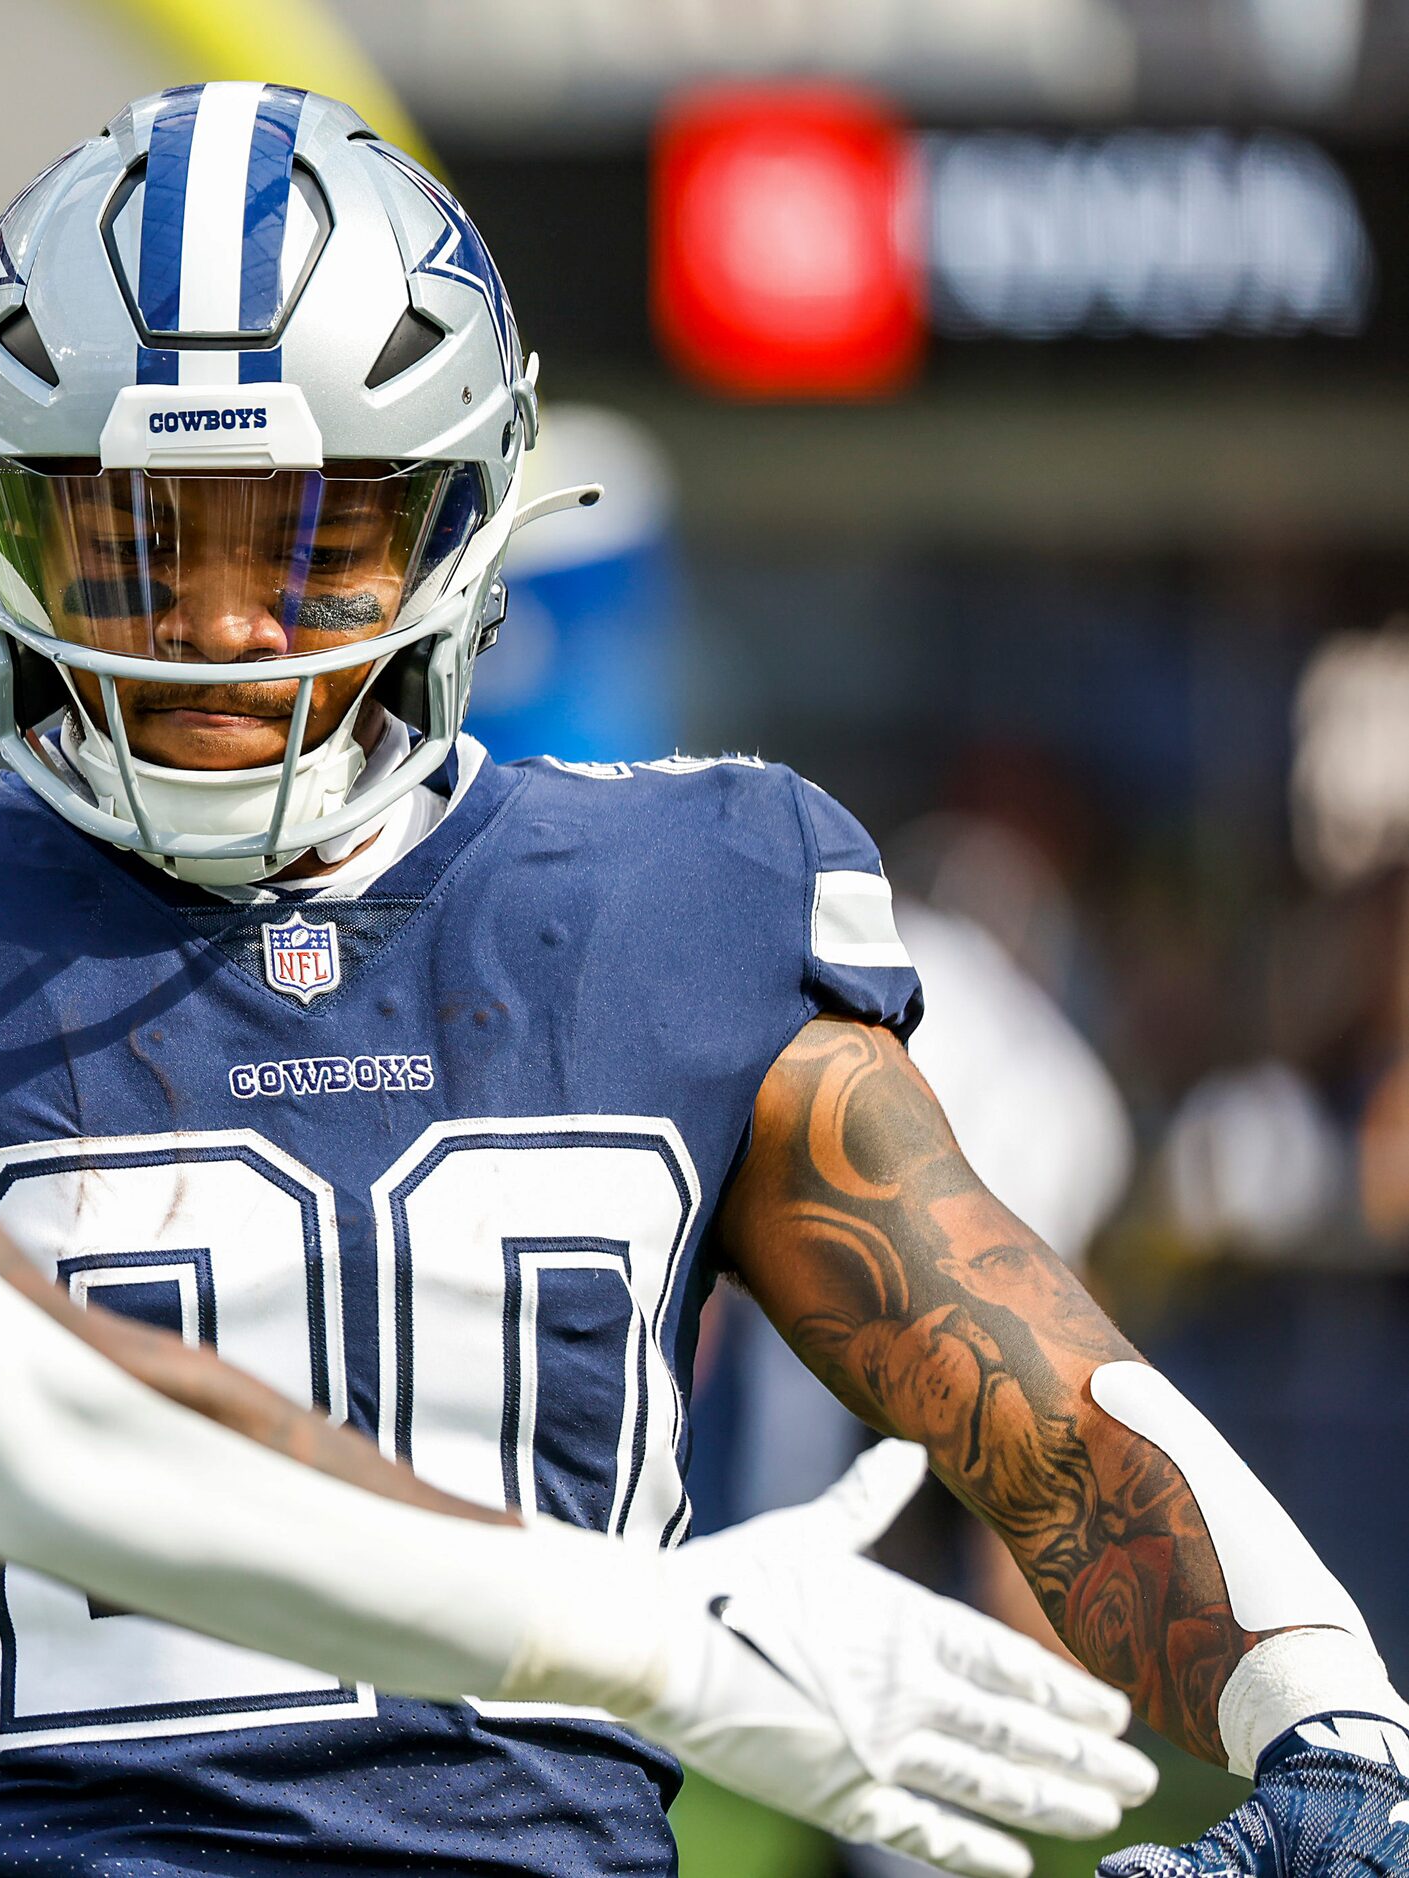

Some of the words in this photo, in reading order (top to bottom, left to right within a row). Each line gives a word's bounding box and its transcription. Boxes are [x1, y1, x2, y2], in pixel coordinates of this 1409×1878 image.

[149, 407, 268, 434] COWBOYS
[276, 950, 329, 986] NFL
[228, 1054, 436, 1099] COWBOYS
